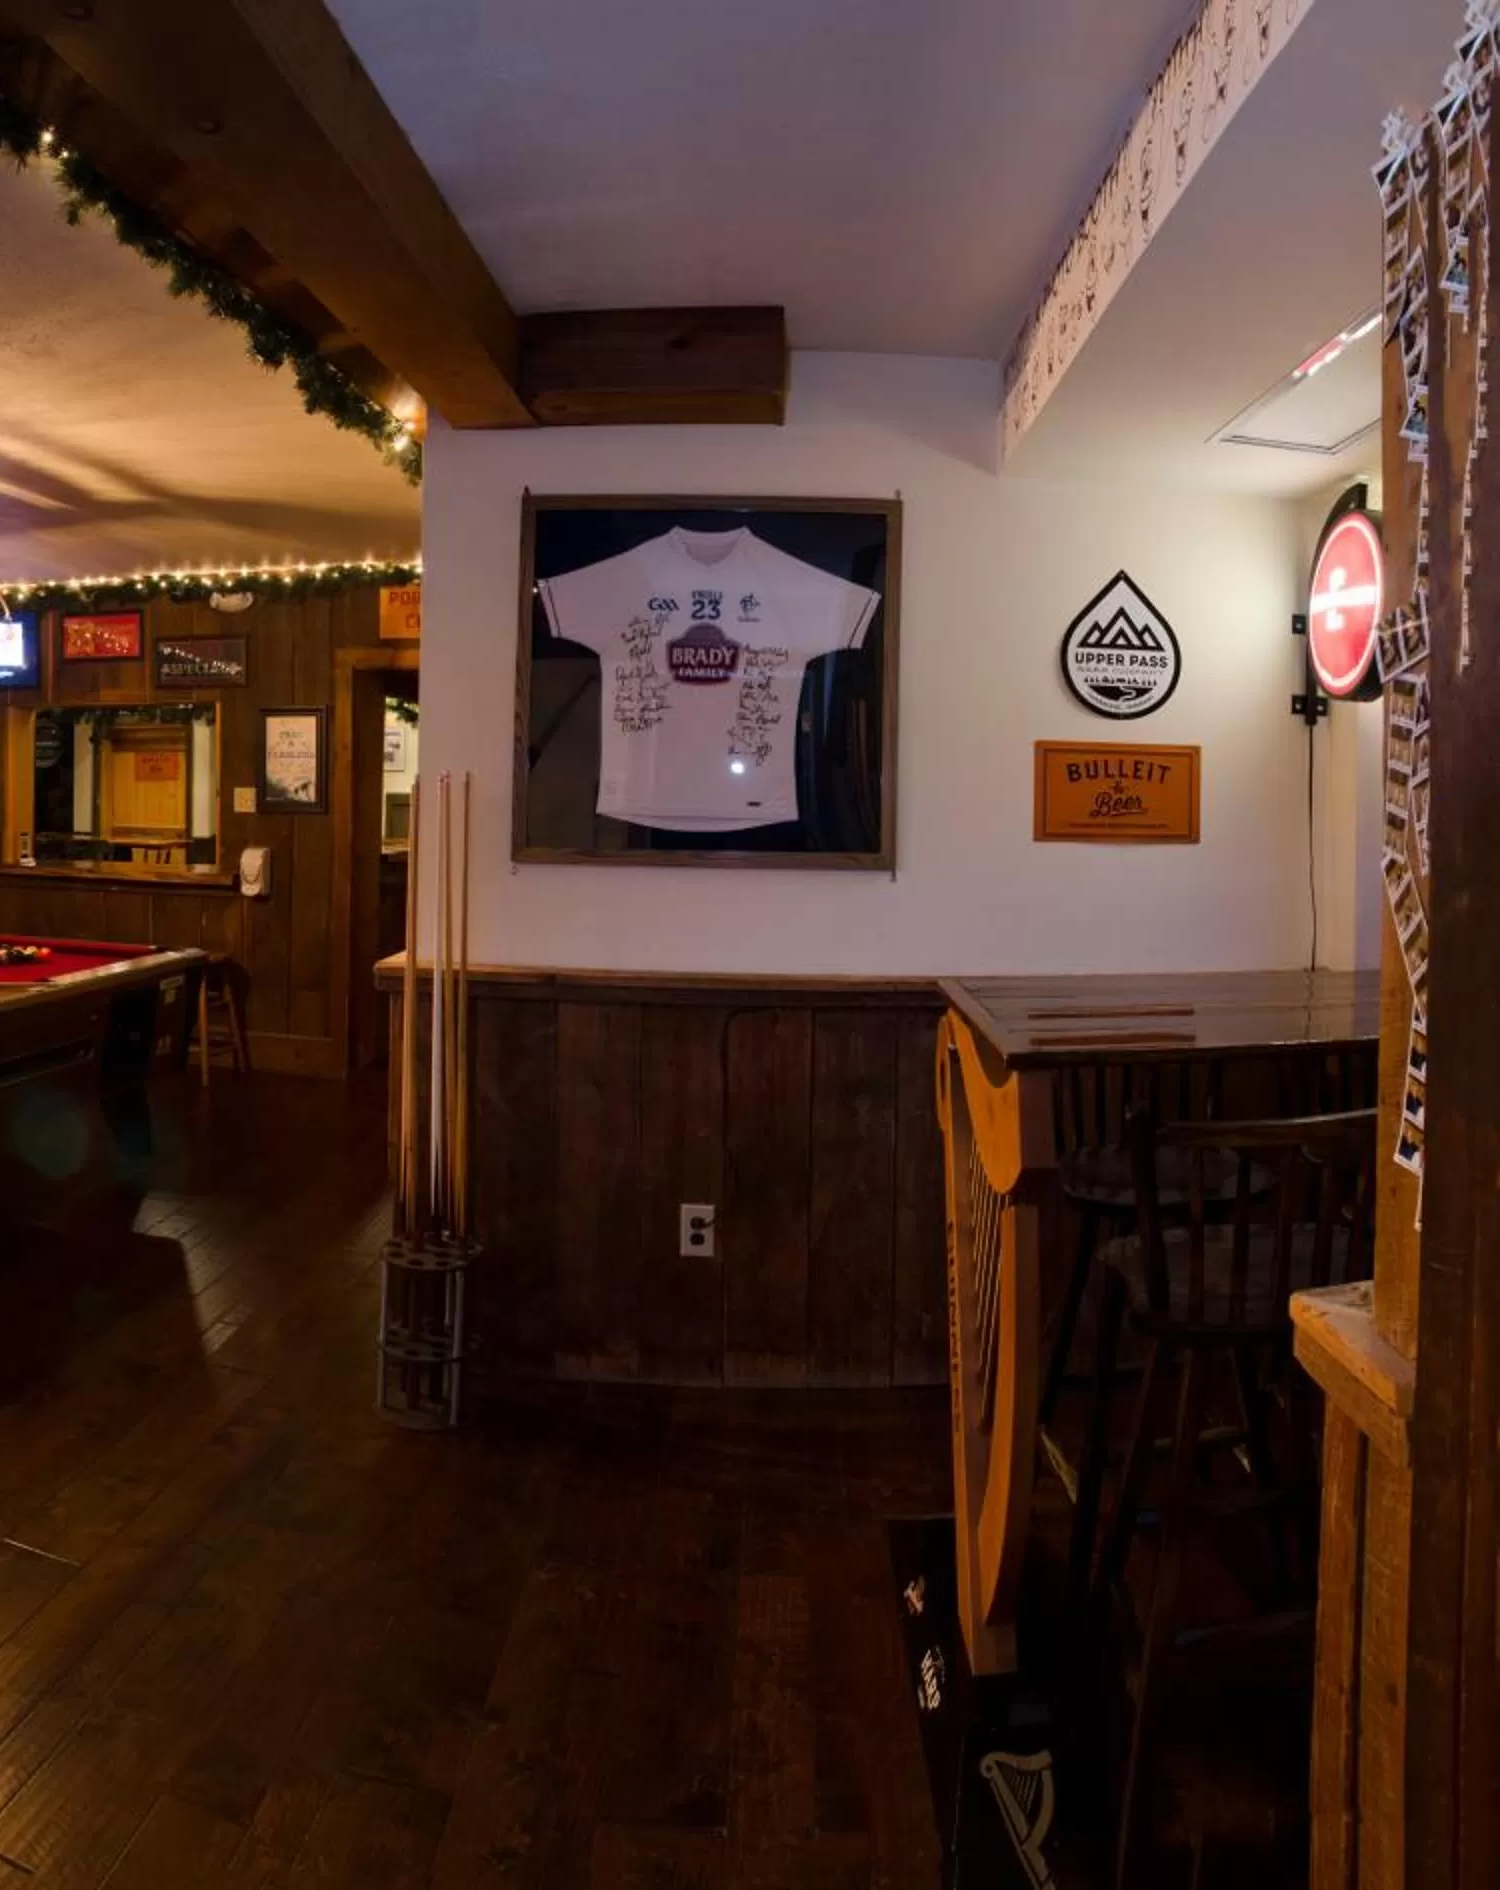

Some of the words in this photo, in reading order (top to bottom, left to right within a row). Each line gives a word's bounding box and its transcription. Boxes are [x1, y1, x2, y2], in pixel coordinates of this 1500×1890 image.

[691, 599, 721, 620] 23
[671, 646, 735, 666] BRADY
[1075, 652, 1125, 667] UPPER
[1129, 654, 1169, 669] PASS
[678, 667, 724, 678] FAMILY
[1066, 758, 1172, 785] BULLEIT
[1089, 791, 1148, 817] Beer
